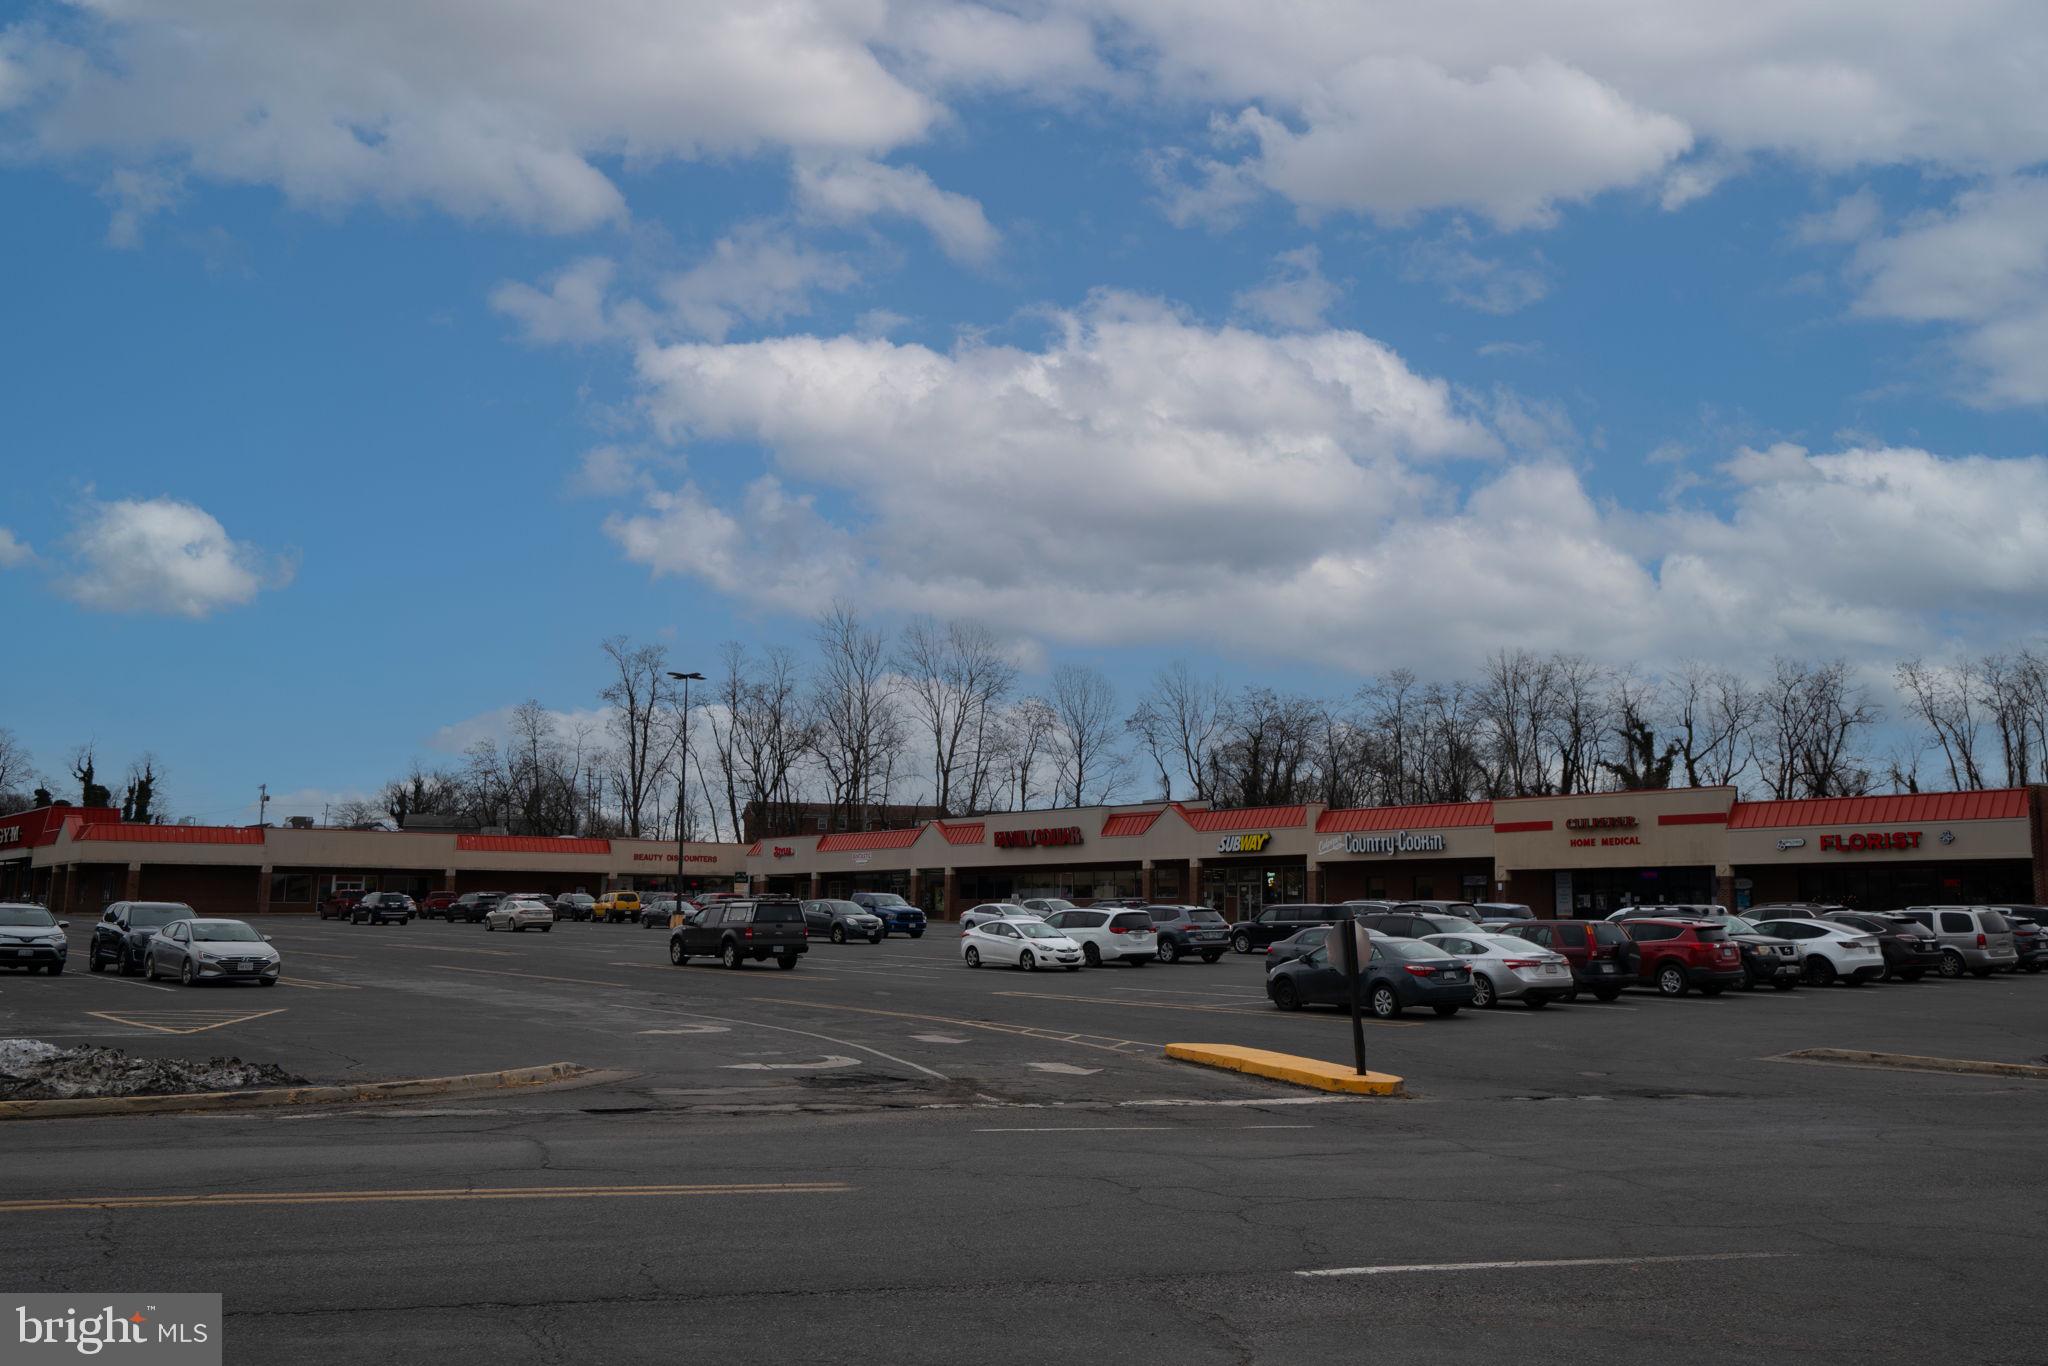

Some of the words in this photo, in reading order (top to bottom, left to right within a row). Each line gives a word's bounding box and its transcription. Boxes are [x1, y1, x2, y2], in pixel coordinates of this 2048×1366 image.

[1217, 832, 1272, 853] SUBWAY
[1570, 838, 1596, 847] HOME
[1601, 837, 1641, 847] MEDICAL
[1820, 832, 1922, 851] FLORIST
[633, 853, 663, 861] BEAUTY
[667, 855, 717, 863] DISOUNTERS
